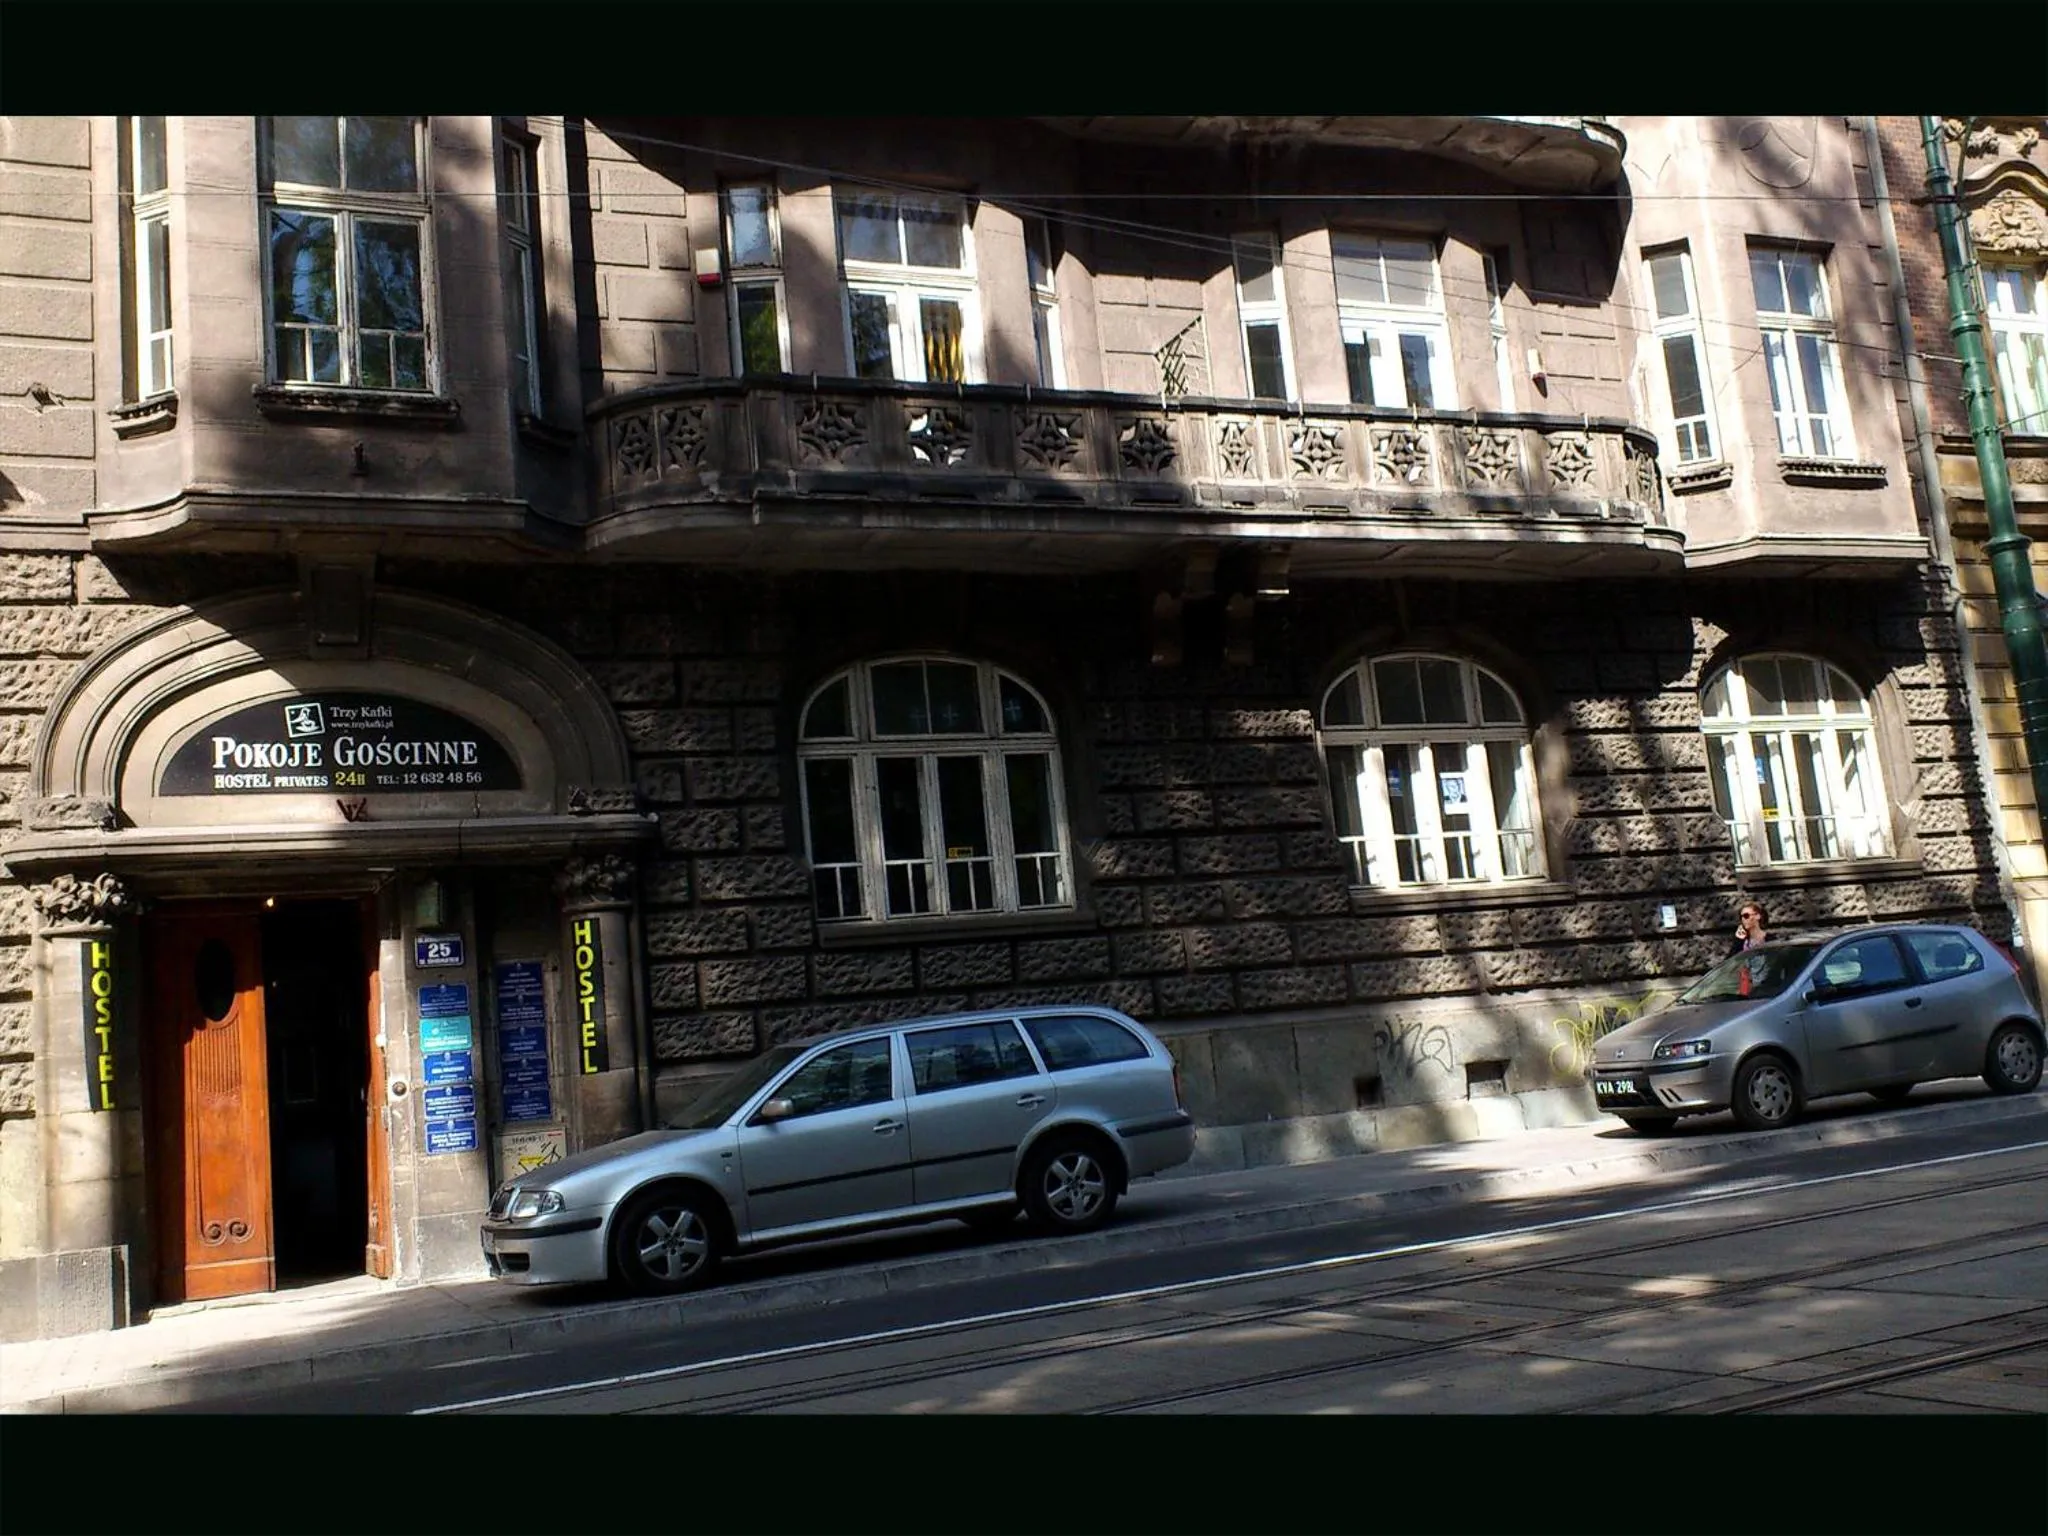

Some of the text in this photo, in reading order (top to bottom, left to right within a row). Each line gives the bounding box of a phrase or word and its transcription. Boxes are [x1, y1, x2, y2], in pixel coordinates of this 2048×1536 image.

[330, 705, 393, 720] Trzy Kafki
[212, 735, 478, 769] POKOJE GOŚCINNE
[213, 773, 271, 789] HOSTEL
[274, 775, 329, 788] PRIVATES
[403, 772, 418, 785] 12
[420, 772, 444, 785] 632
[446, 771, 464, 784] 48
[465, 771, 483, 784] 56
[427, 942, 451, 958] 25
[574, 919, 598, 1074] HOSTEL
[91, 941, 115, 1110] HOSTEL
